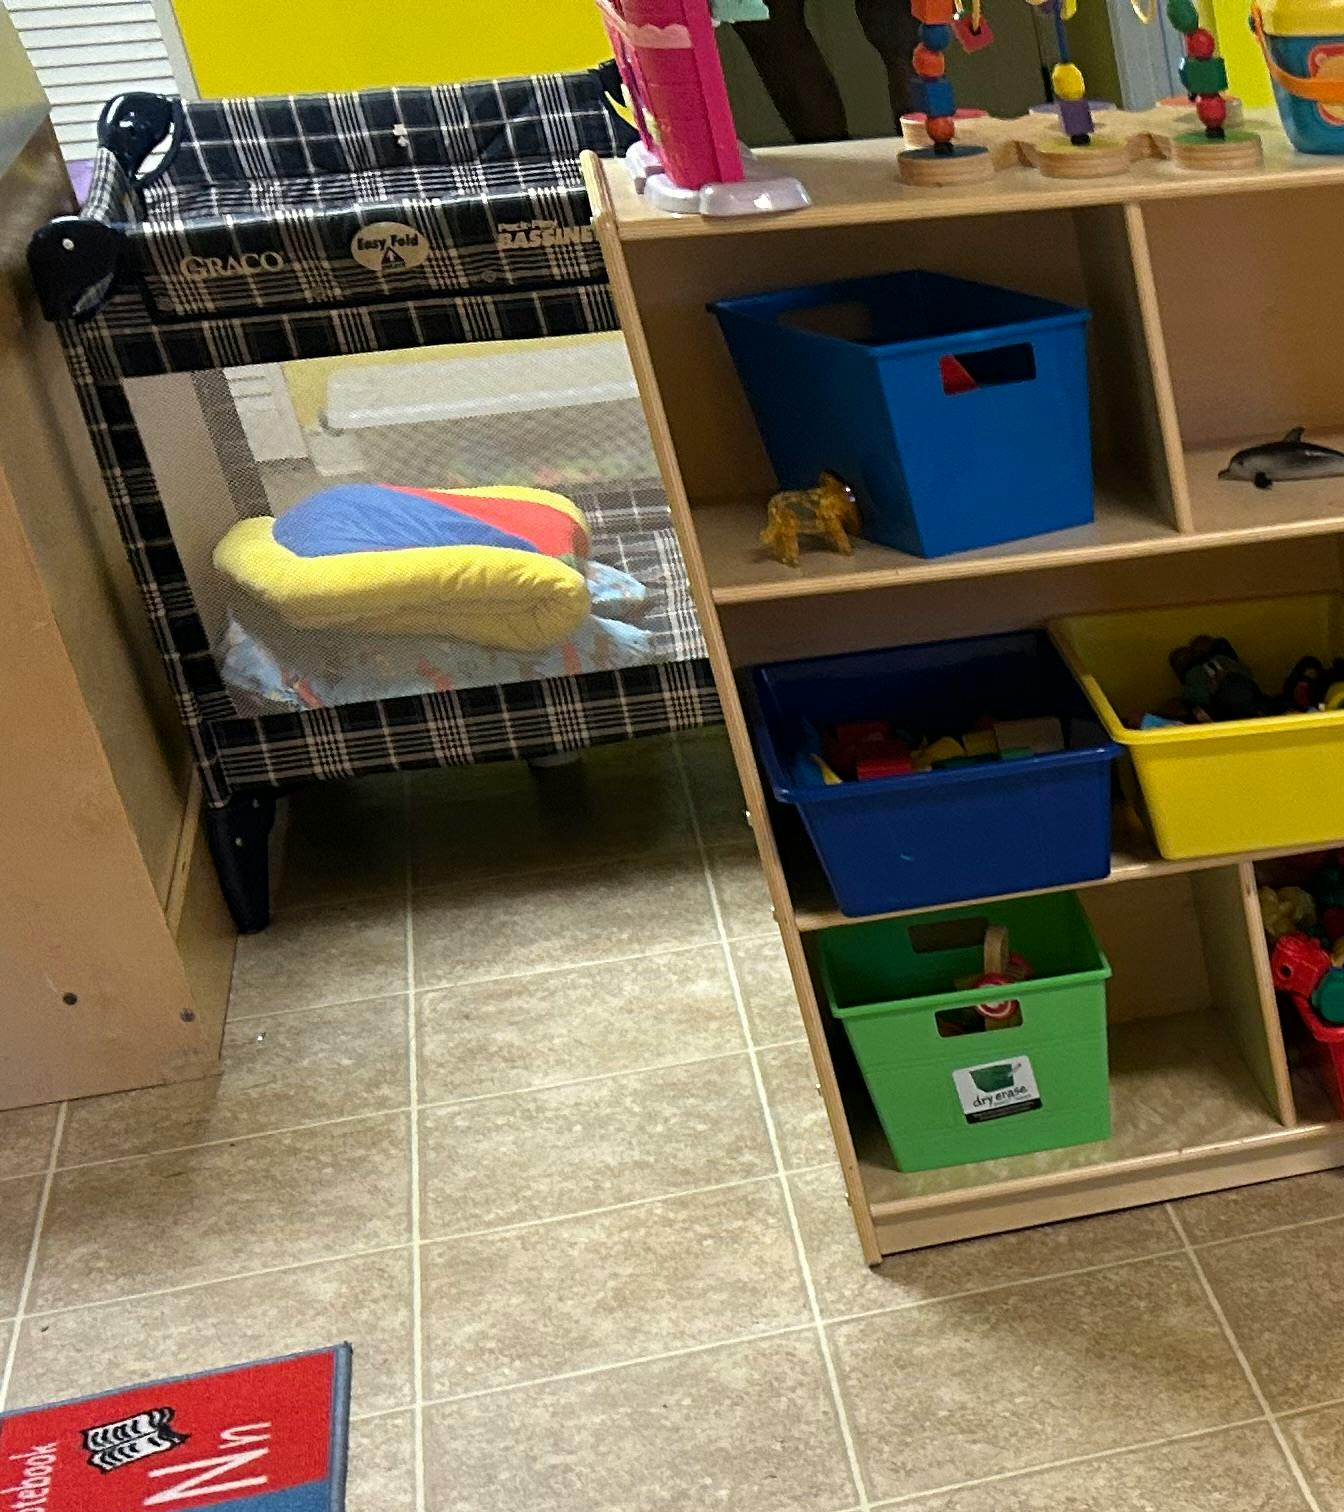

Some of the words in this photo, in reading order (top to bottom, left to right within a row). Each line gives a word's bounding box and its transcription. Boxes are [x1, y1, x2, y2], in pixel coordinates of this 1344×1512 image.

[390, 233, 419, 247] Fold
[496, 225, 595, 250] BASSINE
[180, 251, 284, 280] GRACO
[973, 1094, 993, 1107] dry
[995, 1085, 1028, 1101] erase
